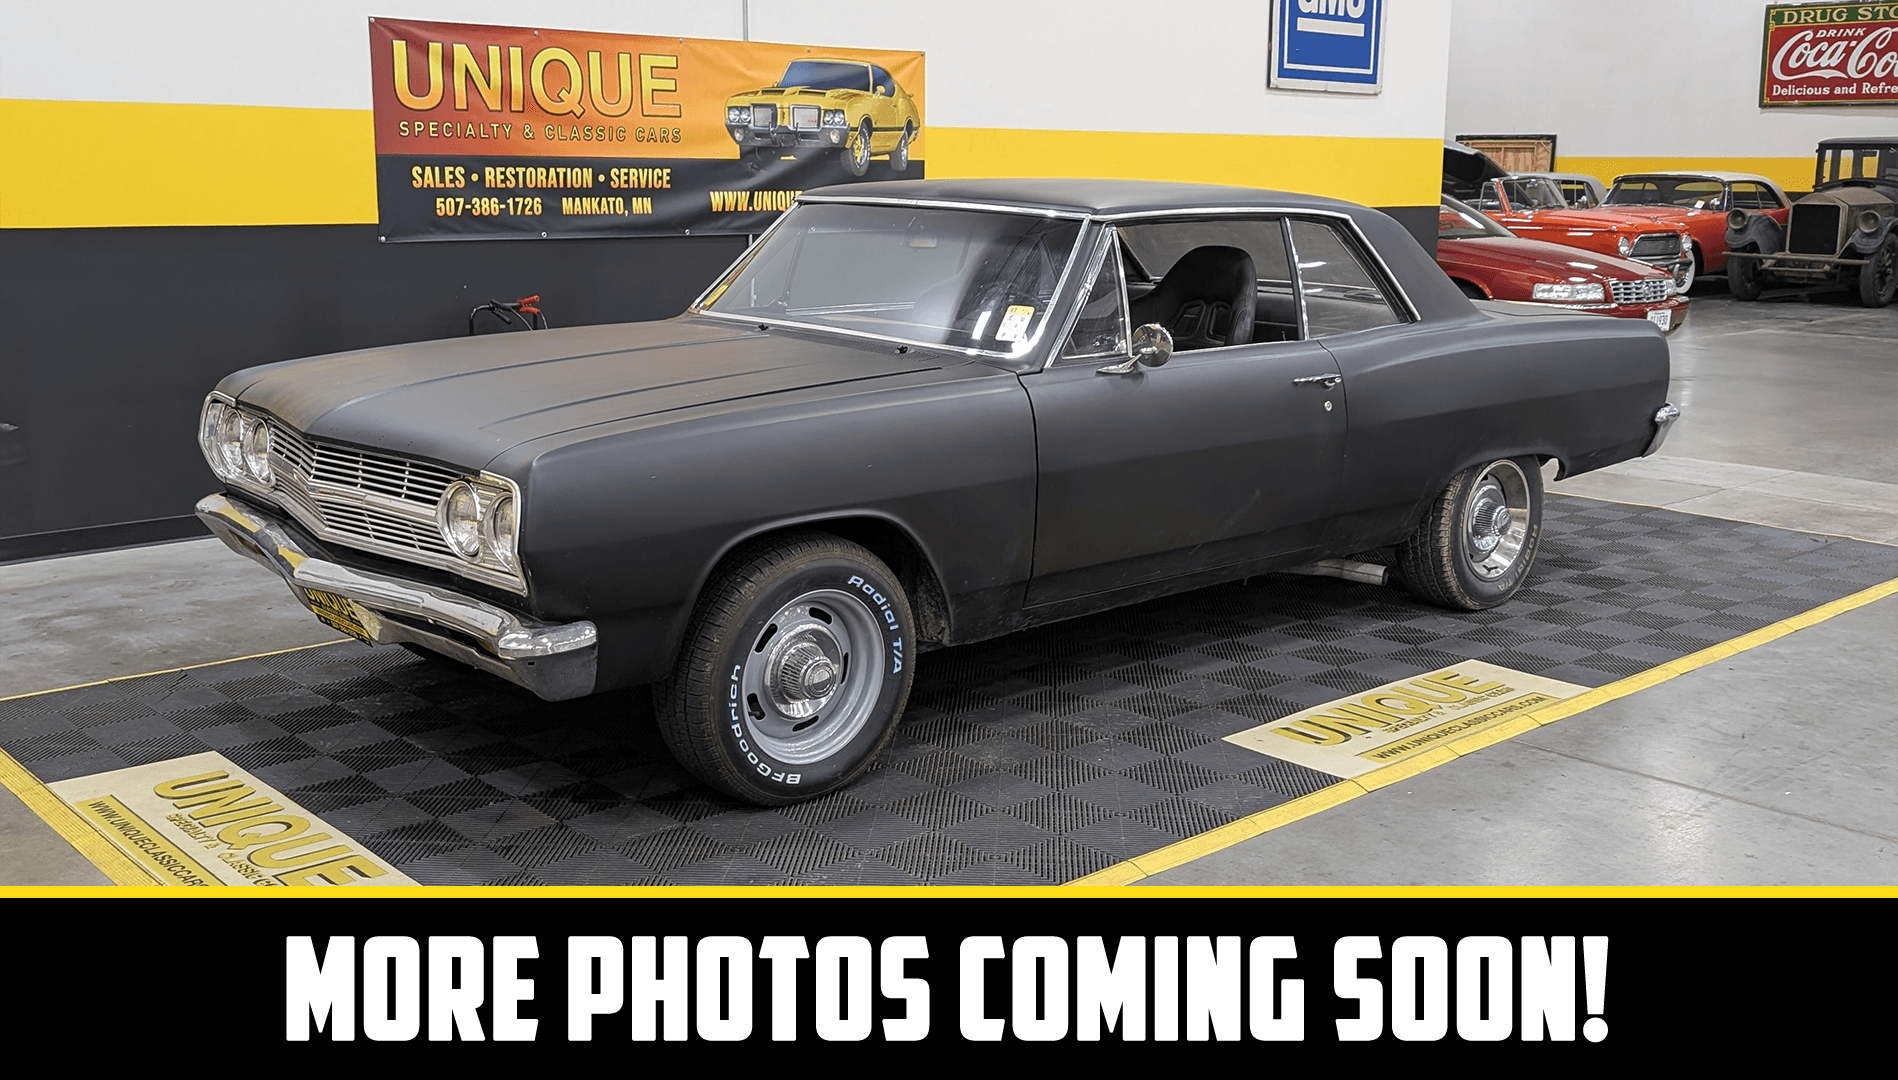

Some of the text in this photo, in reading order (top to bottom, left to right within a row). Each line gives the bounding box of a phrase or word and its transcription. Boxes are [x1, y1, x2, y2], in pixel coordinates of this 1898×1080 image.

[1782, 8, 1848, 24] DRUG
[1815, 27, 1867, 38] DRINK
[392, 39, 683, 118] UNIQUE
[1771, 26, 1898, 80] Coca-Co
[1772, 84, 1831, 96] Delicious
[1833, 82, 1857, 94] and
[399, 120, 682, 143] SPECIALTY & CLASSIC CARS
[411, 165, 672, 190] SALES RESTORATION SERVICE
[435, 196, 653, 217] 507-386-1726 MANKATO, MN
[847, 574, 903, 674] Radial T/A
[728, 663, 802, 784] BFGoodrich
[1268, 670, 1506, 746] UNIQUE
[1372, 695, 1549, 760] WWW.UNIQUECLASSICCARS.COM
[153, 769, 389, 886] UNIQUE
